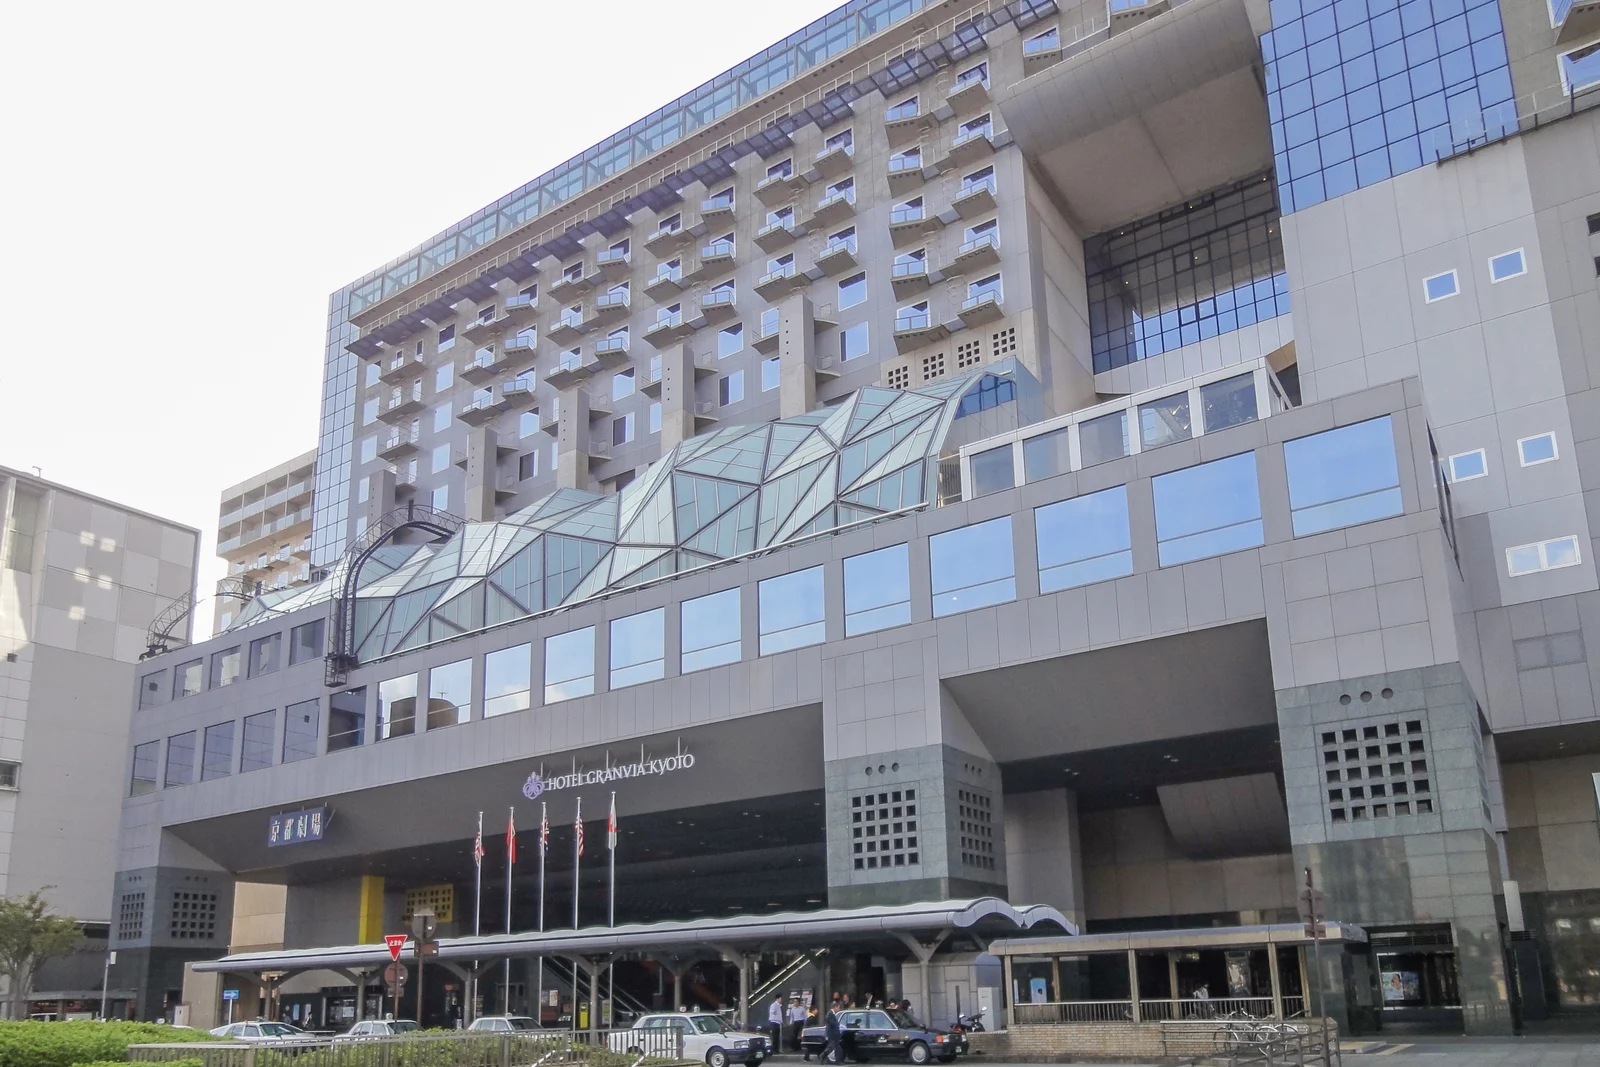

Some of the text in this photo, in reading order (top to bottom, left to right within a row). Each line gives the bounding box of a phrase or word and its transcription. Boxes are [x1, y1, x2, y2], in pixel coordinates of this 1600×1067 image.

[547, 753, 695, 791] HOTEL GRANVIA KYOTO
[271, 812, 321, 843] 京都劇場
